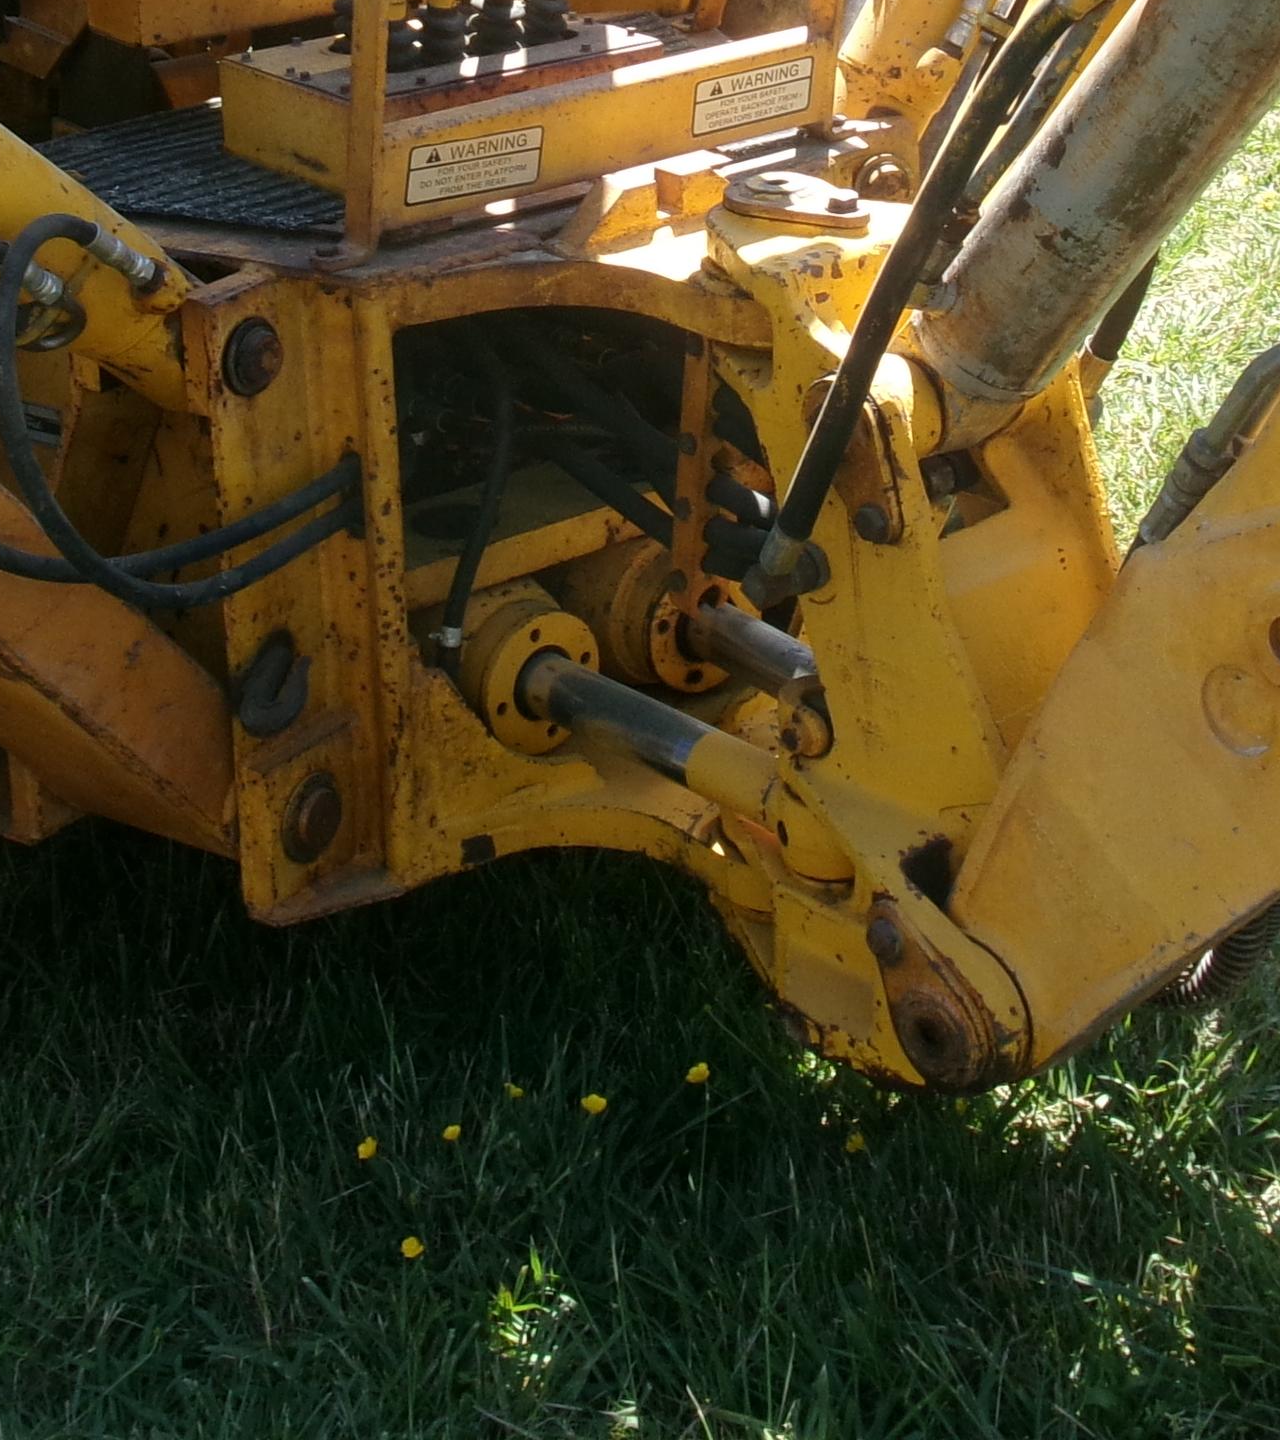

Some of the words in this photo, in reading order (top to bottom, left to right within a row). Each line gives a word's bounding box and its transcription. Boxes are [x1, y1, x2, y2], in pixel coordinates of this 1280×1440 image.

[730, 64, 800, 91] WARNING
[737, 93, 757, 104] YOUR
[759, 87, 786, 98] SAFETY
[705, 108, 738, 120] OPERATE
[450, 133, 528, 160] WARNING
[437, 165, 455, 176] FOR
[457, 162, 480, 172] YOUR
[482, 157, 512, 169] SAFETY
[420, 181, 433, 189] DO
[435, 177, 452, 187] NOT
[455, 172, 482, 182] ENTER
[484, 164, 527, 178] PLATFORM
[440, 184, 464, 195] FROM
[466, 182, 482, 190] THE
[485, 177, 507, 187] REAR
